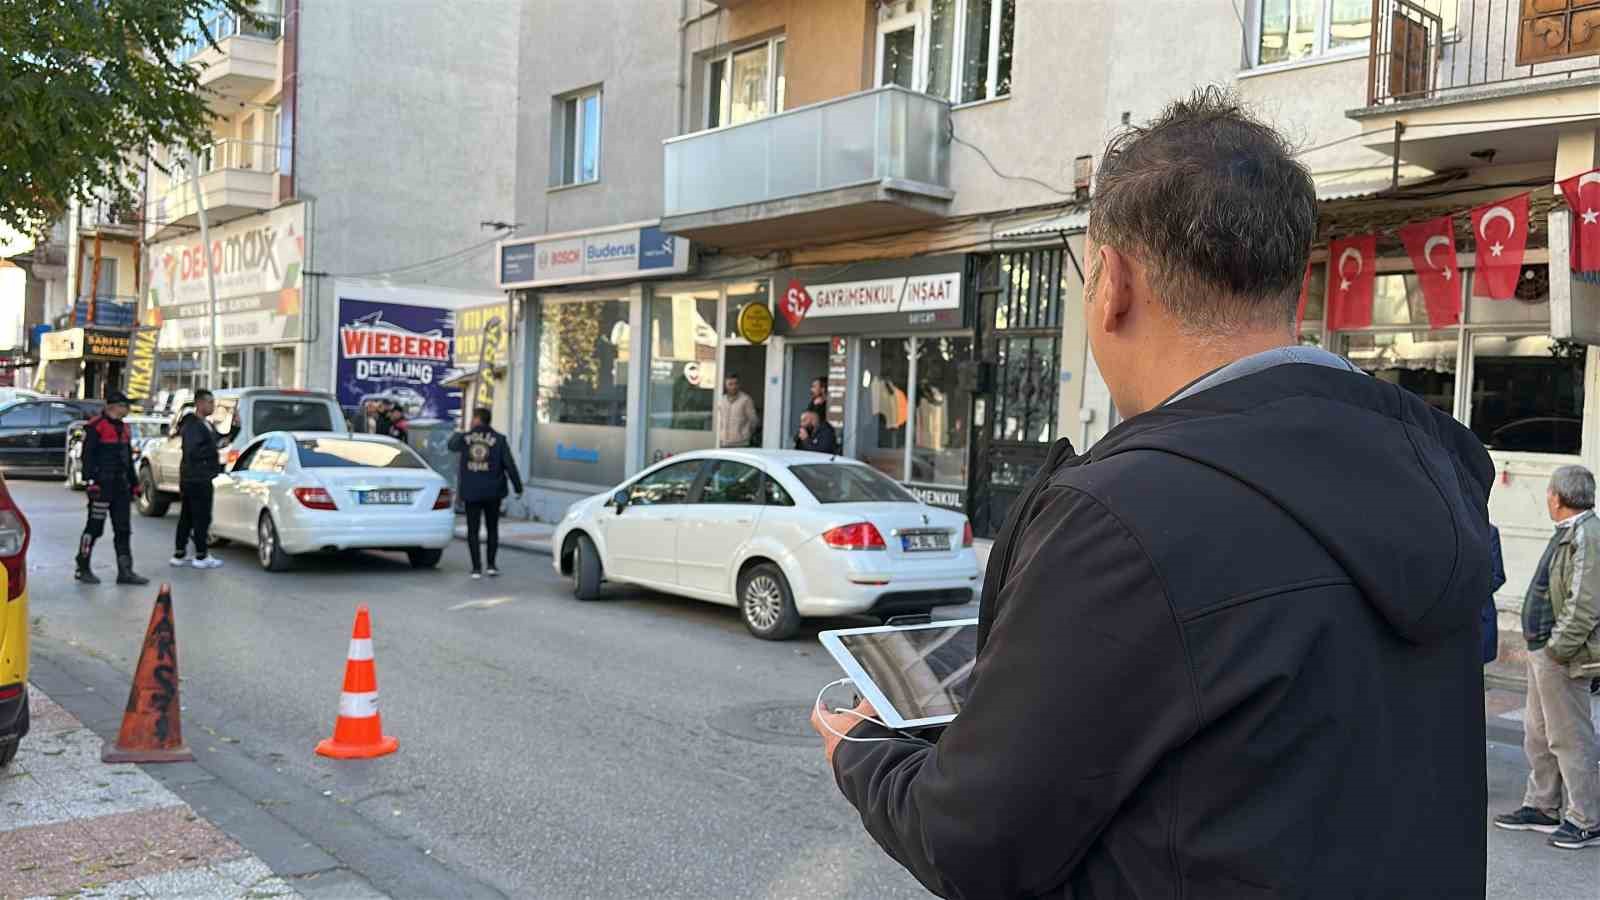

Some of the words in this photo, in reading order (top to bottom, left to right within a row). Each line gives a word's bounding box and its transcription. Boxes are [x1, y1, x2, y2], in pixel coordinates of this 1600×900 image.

[586, 242, 636, 259] Buderus
[342, 327, 449, 360] WIEBERR
[127, 330, 158, 399] YIKAMA
[356, 360, 433, 384] DETAILING
